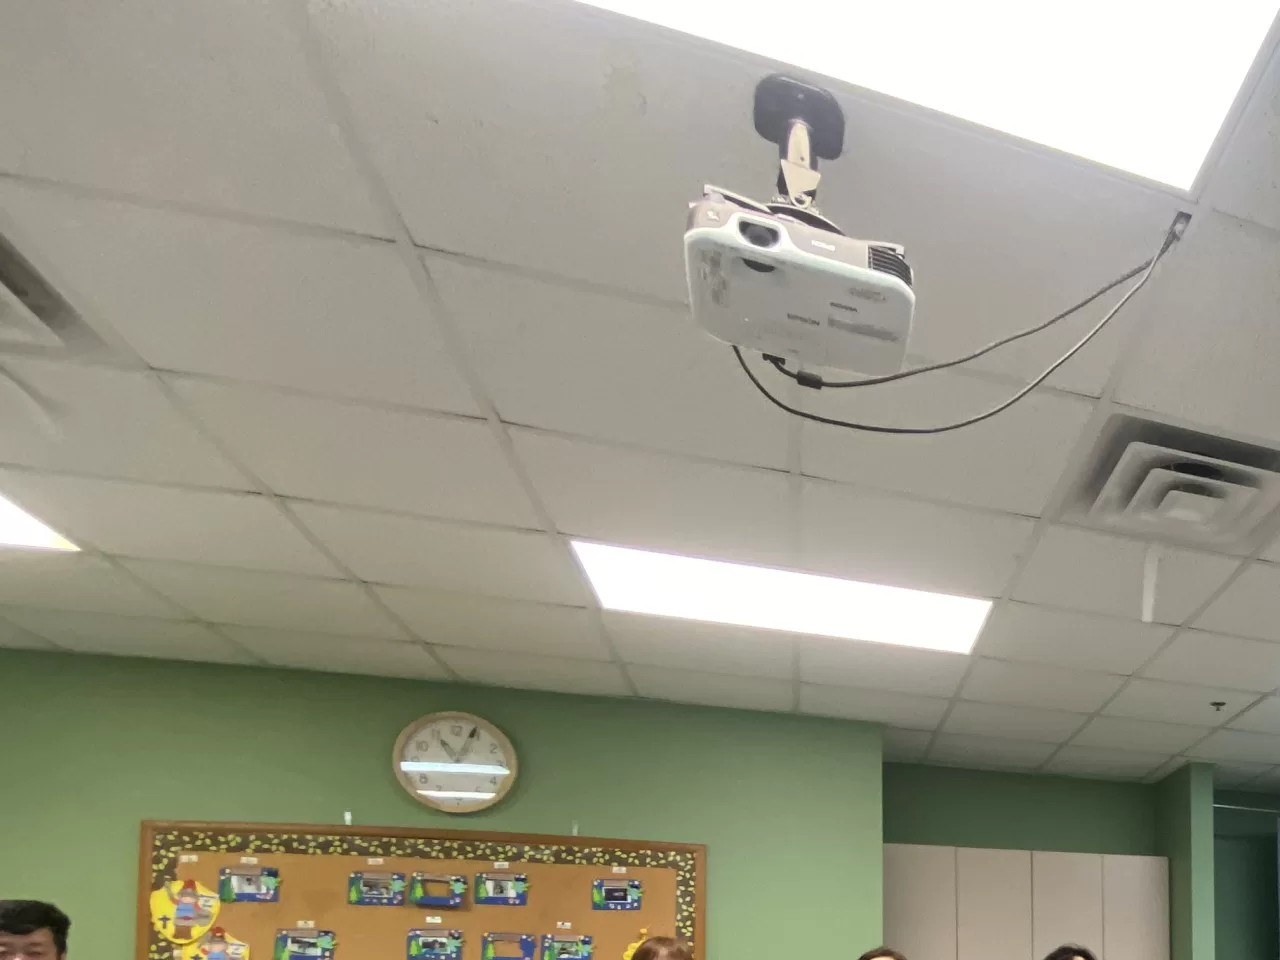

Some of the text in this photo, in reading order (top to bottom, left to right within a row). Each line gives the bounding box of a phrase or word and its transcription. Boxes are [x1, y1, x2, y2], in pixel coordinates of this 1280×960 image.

[416, 740, 429, 752] 10
[489, 743, 498, 754] 2
[419, 773, 429, 784] 8
[488, 775, 497, 786] 4
